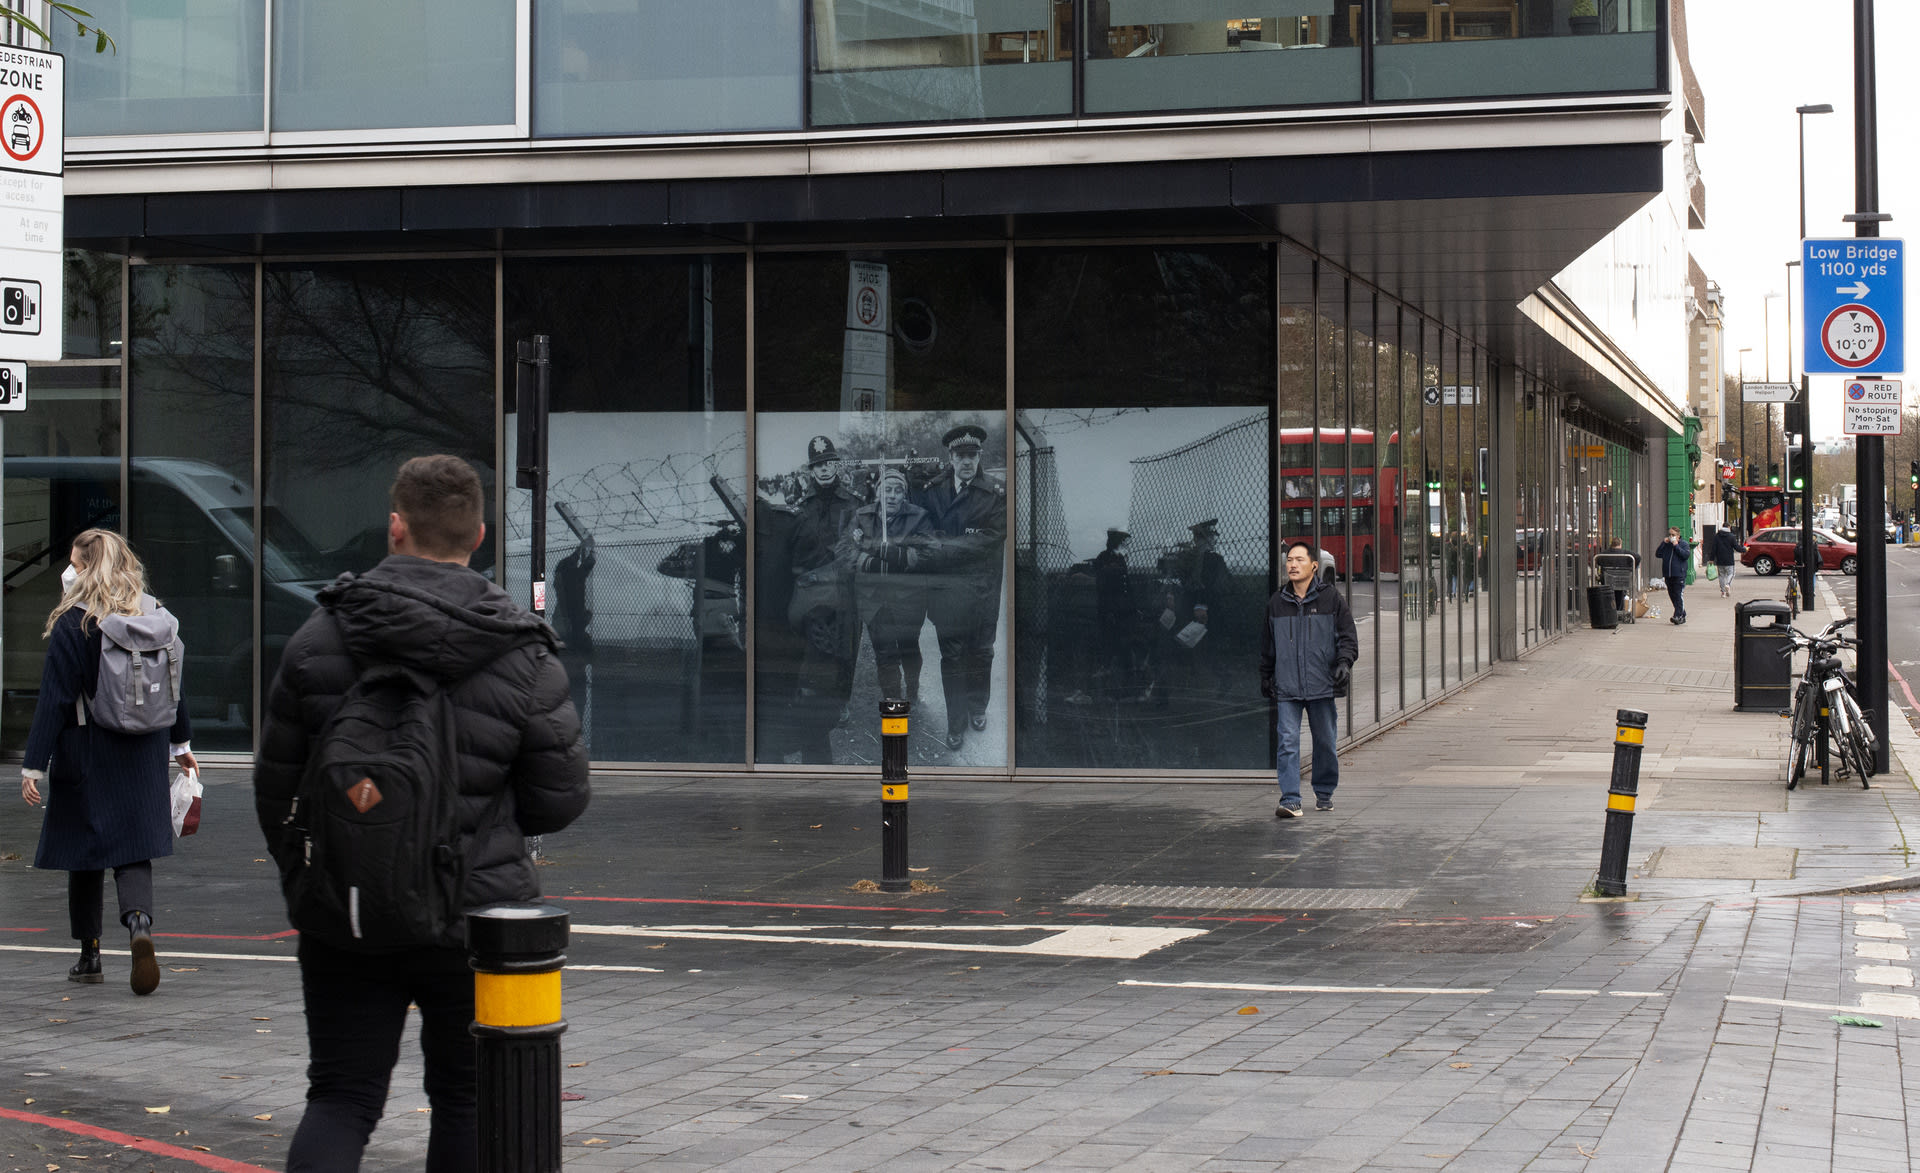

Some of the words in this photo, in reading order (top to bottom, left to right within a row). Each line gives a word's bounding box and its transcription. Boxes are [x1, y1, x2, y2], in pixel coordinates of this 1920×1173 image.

[0, 52, 52, 69] EDESTRIAN
[0, 68, 43, 91] ZONE
[31, 179, 43, 190] for
[5, 192, 35, 202] access
[20, 217, 30, 228] At
[34, 220, 48, 232] any
[25, 232, 44, 243] time
[1810, 246, 1840, 259] Low
[1846, 246, 1898, 261] Bridge
[1820, 262, 1855, 276] 1100
[1860, 262, 1887, 278] yds
[1874, 384, 1893, 392] RED
[1867, 392, 1898, 400] ROUTE
[1848, 406, 1860, 414] No
[1862, 407, 1898, 416] stopping
[1855, 414, 1890, 422] Mon-Sat
